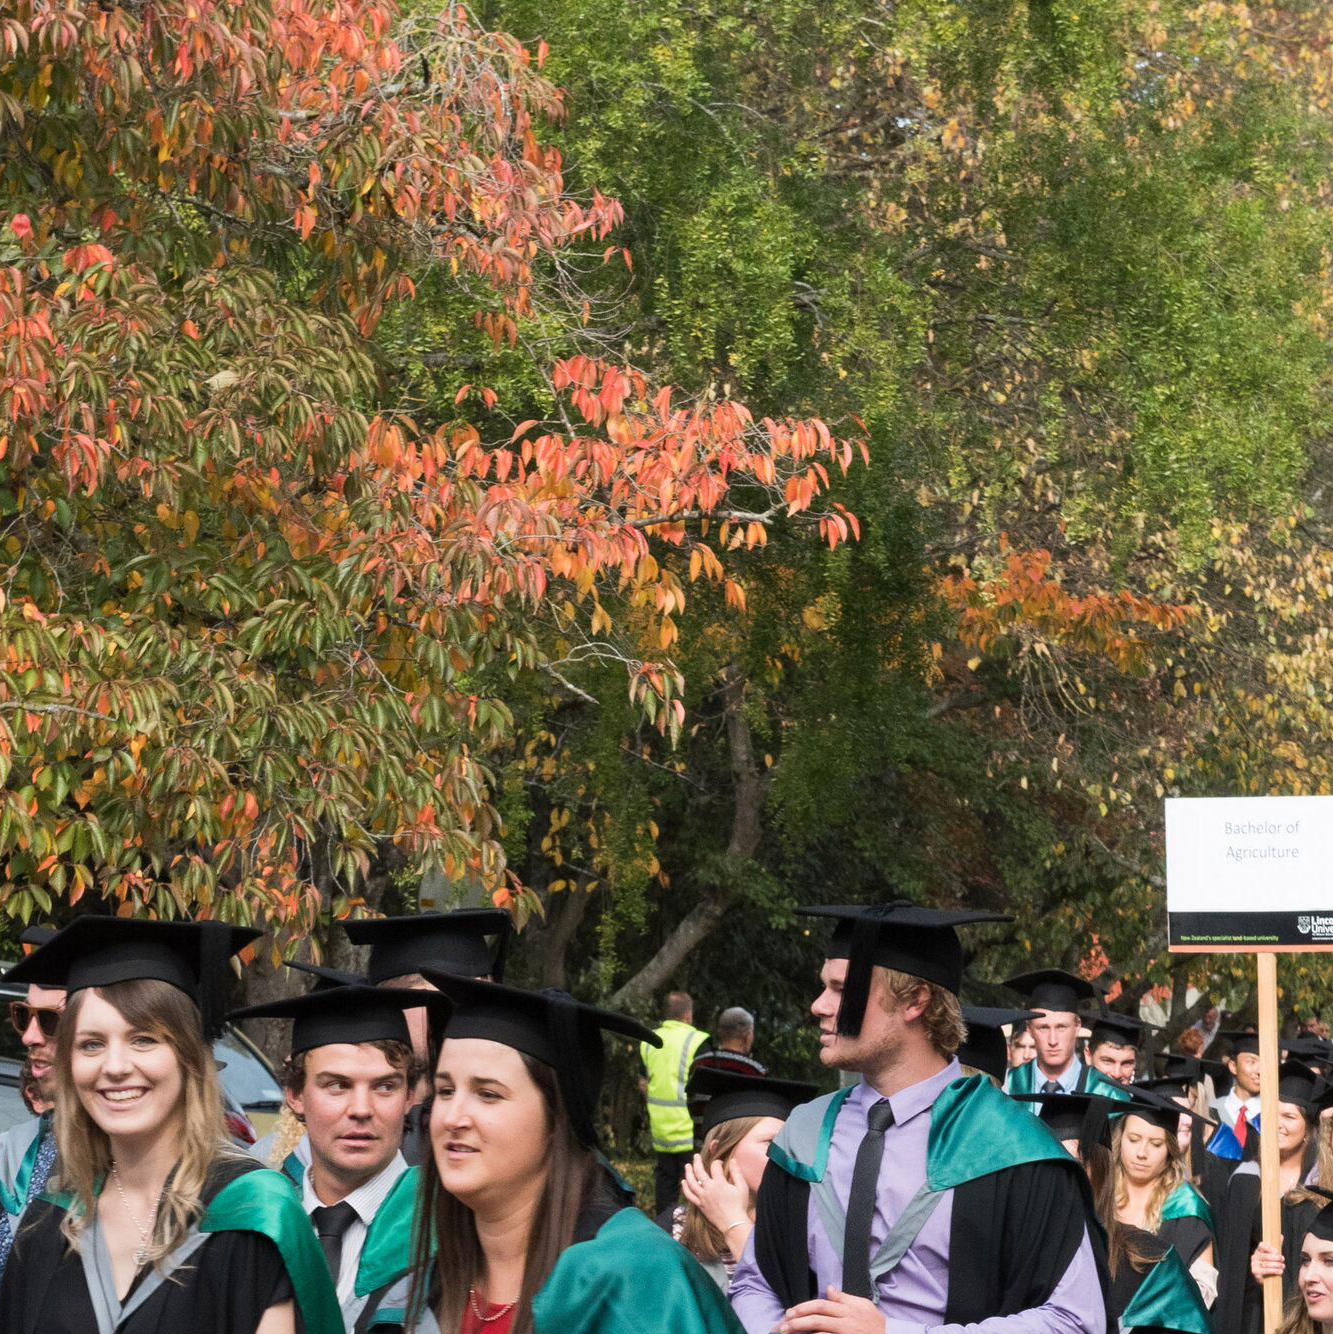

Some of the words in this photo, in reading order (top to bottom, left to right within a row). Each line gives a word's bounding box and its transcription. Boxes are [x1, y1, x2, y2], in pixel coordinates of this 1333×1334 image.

[1224, 820, 1283, 835] Bachelor
[1286, 819, 1300, 835] of
[1226, 844, 1300, 862] Agriculture
